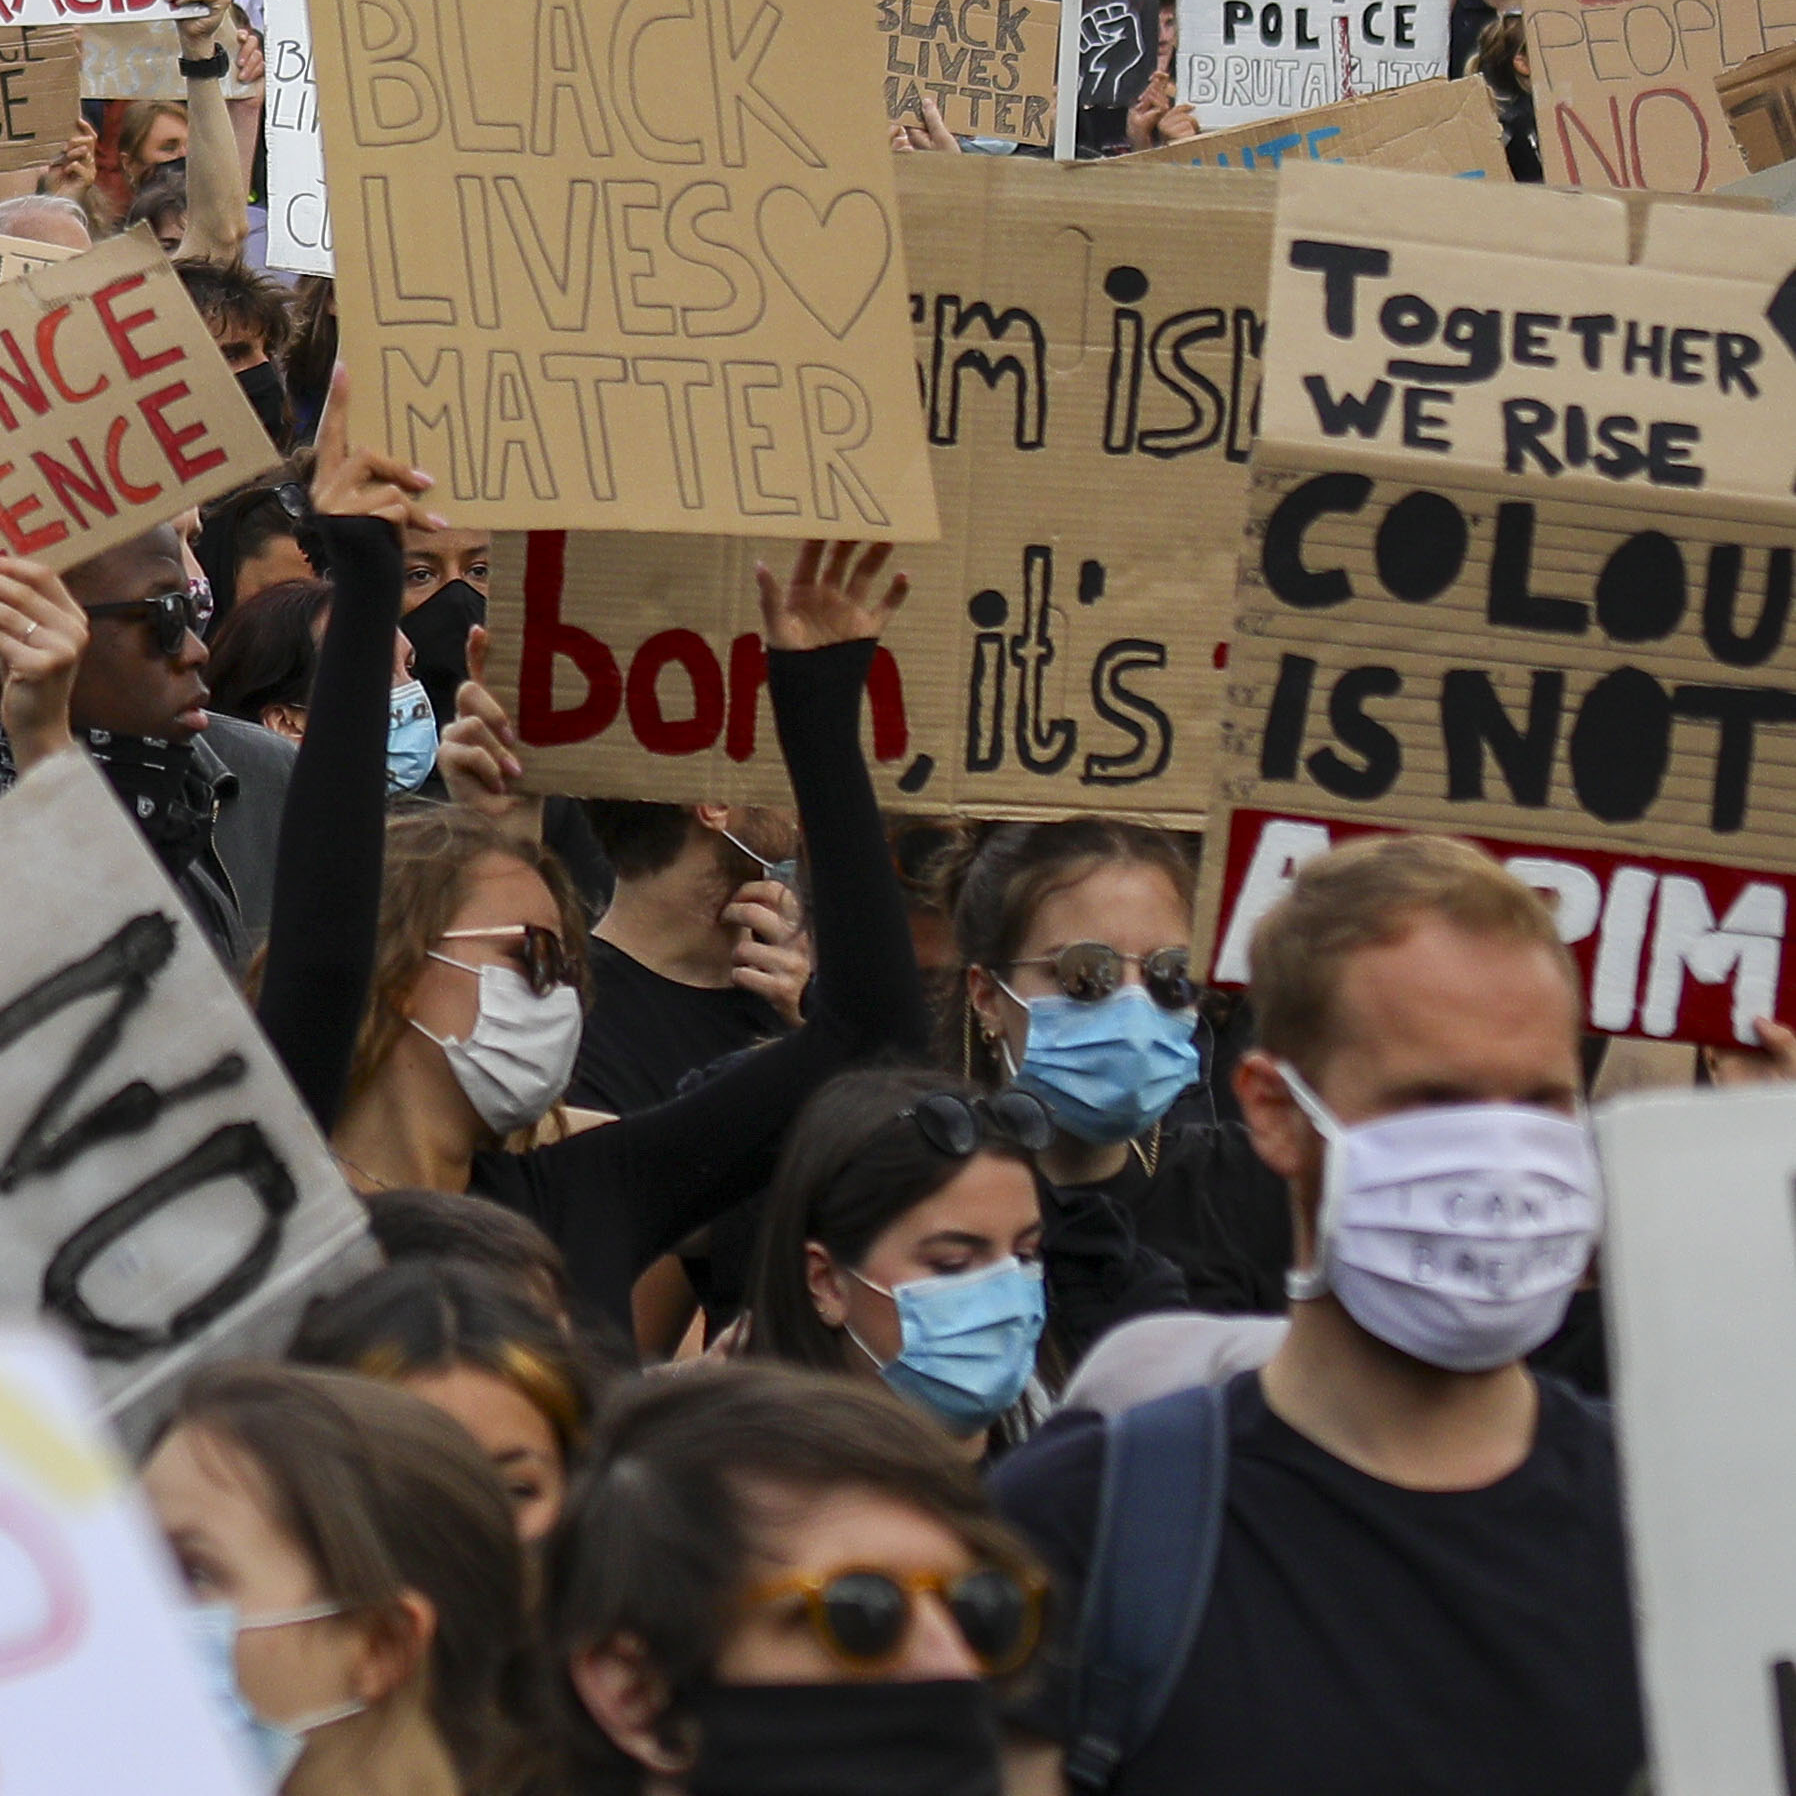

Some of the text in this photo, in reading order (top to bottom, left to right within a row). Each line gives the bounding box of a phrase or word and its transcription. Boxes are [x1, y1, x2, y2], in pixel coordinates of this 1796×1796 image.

[887, 34, 1021, 93] LIVES
[1553, 86, 1711, 194] NO
[360, 174, 768, 340] LIVES
[381, 346, 892, 529] MATTER
[1301, 371, 1706, 490] WE RISE
[1259, 470, 1796, 670] COLOU
[965, 544, 1176, 786] it's
[1255, 650, 1796, 836] IS NOT
